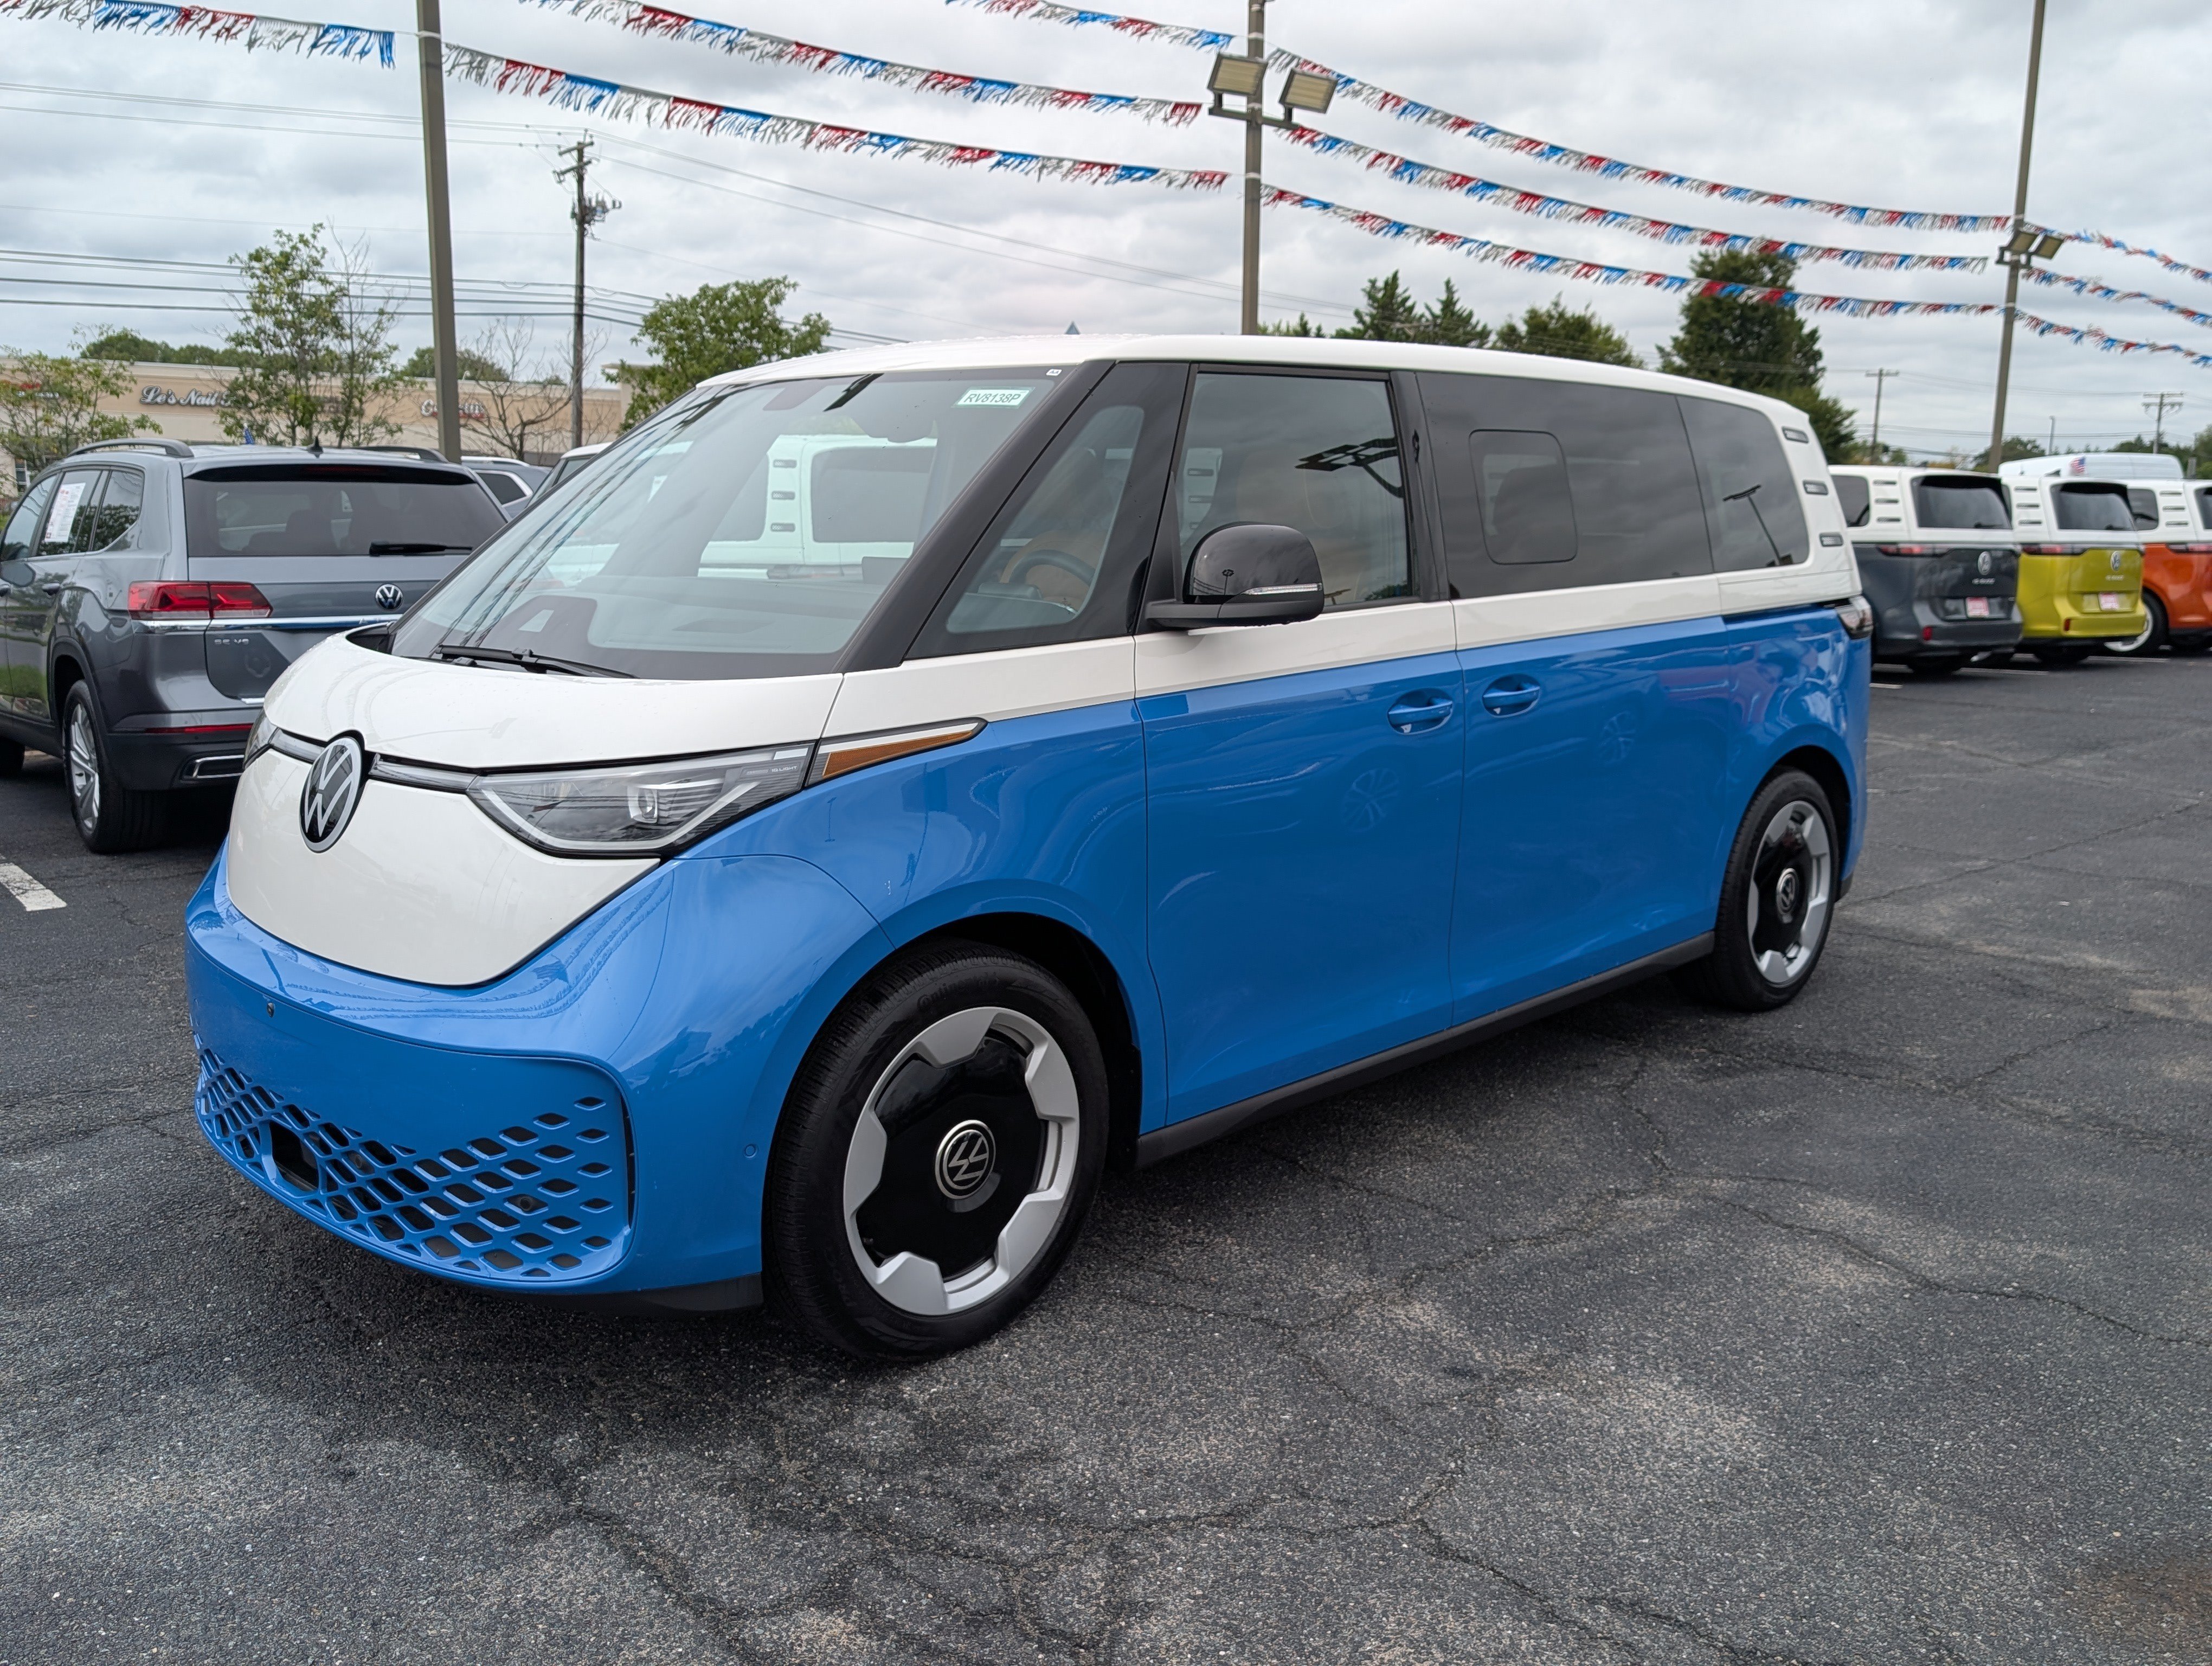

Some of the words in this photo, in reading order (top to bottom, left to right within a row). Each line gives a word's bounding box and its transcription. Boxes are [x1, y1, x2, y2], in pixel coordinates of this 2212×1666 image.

[140, 386, 177, 405] Le's
[179, 388, 218, 406] Nail
[963, 393, 1021, 403] RV8138P
[301, 740, 360, 849] VW
